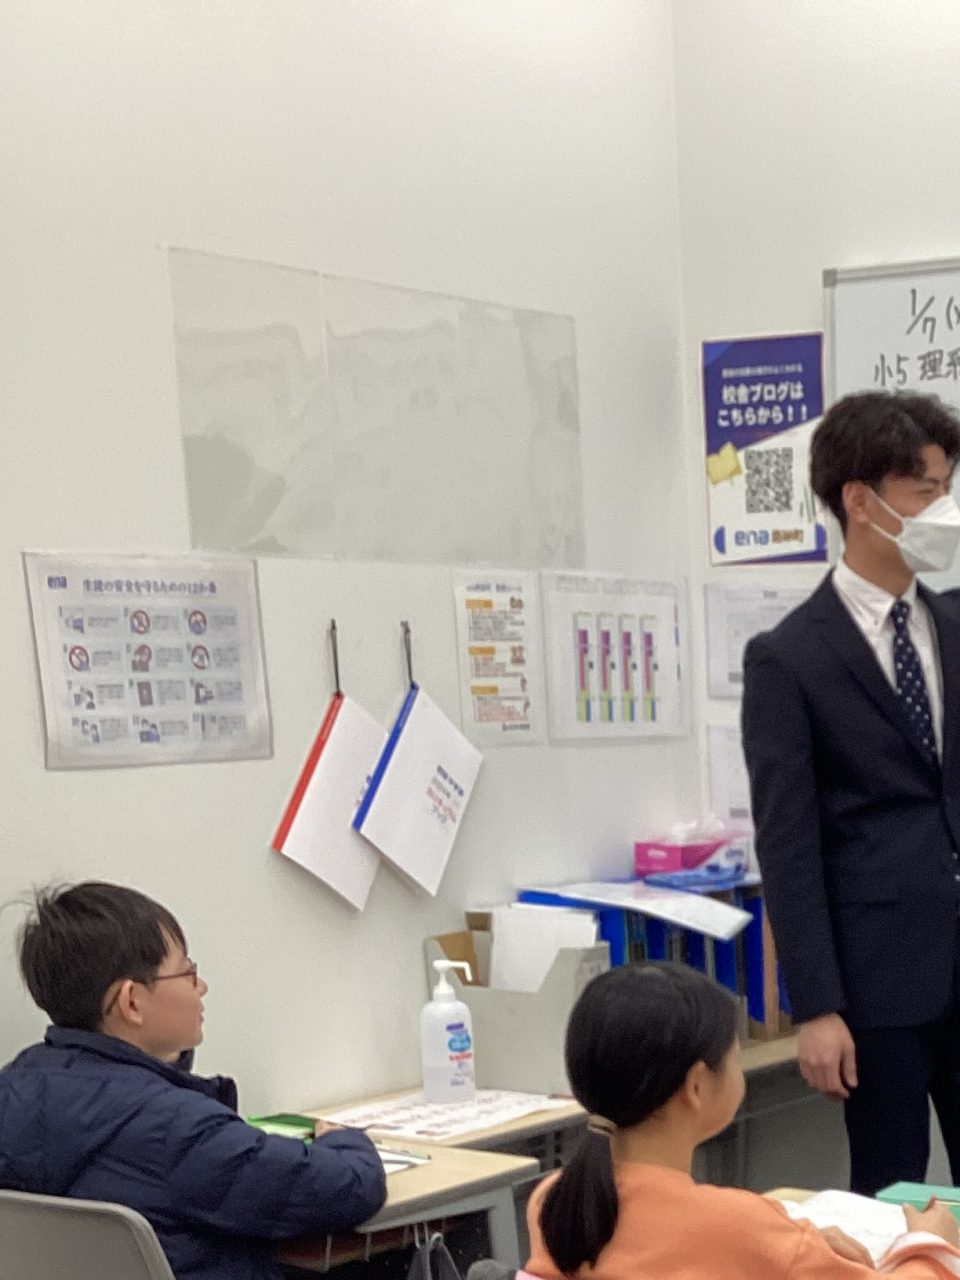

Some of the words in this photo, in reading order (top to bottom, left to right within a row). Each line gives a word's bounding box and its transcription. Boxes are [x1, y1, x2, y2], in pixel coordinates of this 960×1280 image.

[722, 381, 804, 405] 校舎ブログは
[734, 530, 769, 546] ena
